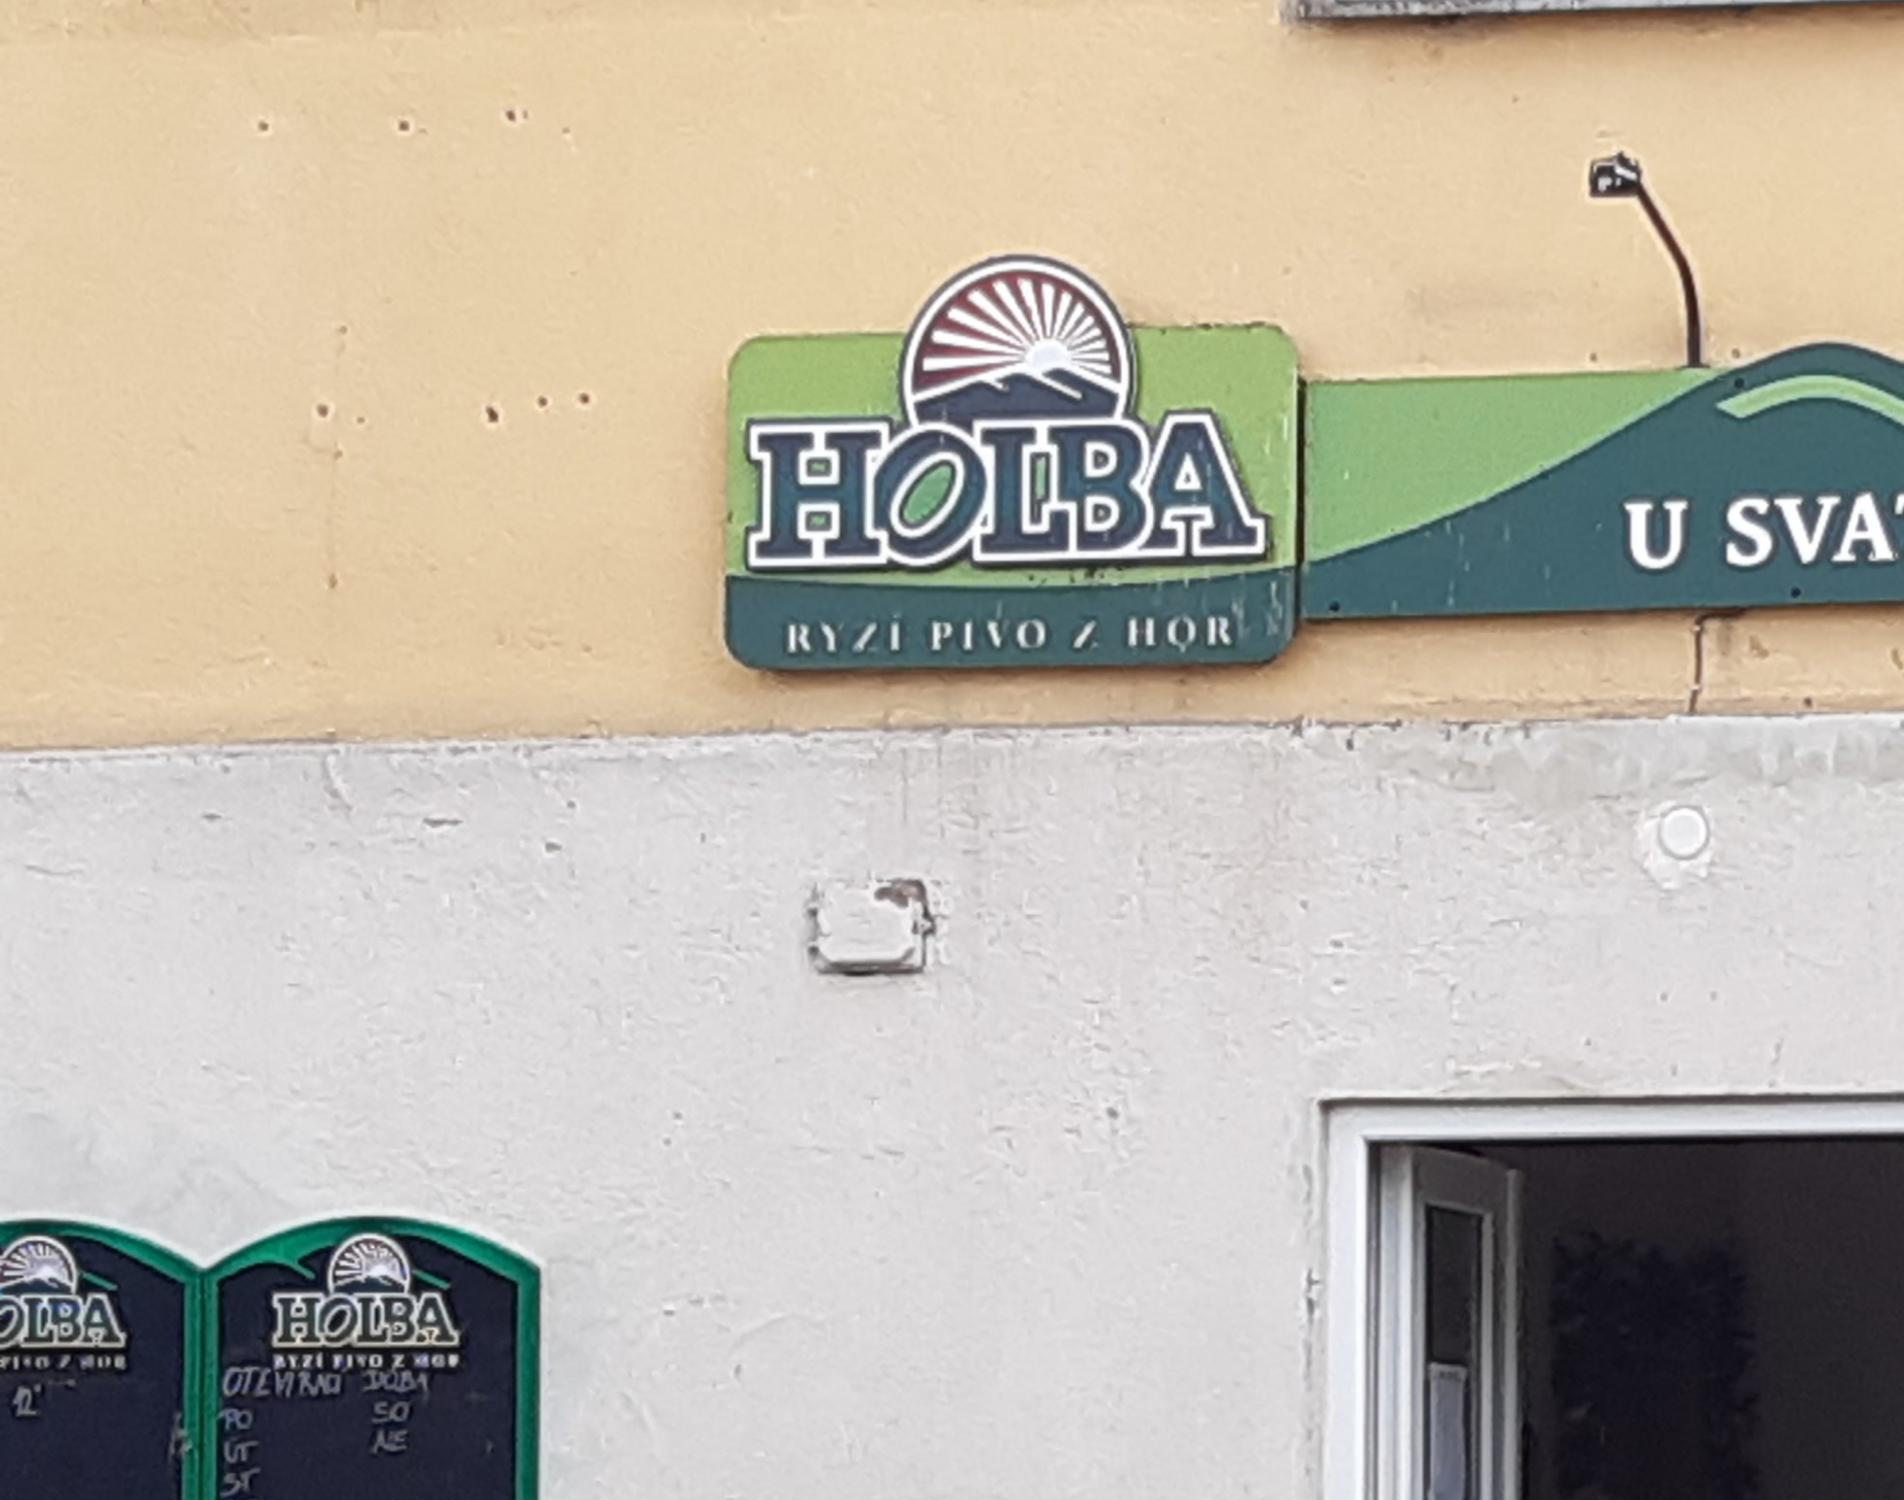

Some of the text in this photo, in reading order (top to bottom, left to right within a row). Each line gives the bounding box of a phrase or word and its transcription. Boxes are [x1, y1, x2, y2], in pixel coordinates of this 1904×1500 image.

[746, 408, 1268, 571] HOLBA
[1624, 500, 1689, 571] U
[930, 615, 1047, 651] PIVO
[0, 1292, 127, 1349] OLBA
[271, 1292, 460, 1349] HOLBA
[371, 1400, 410, 1424] SO
